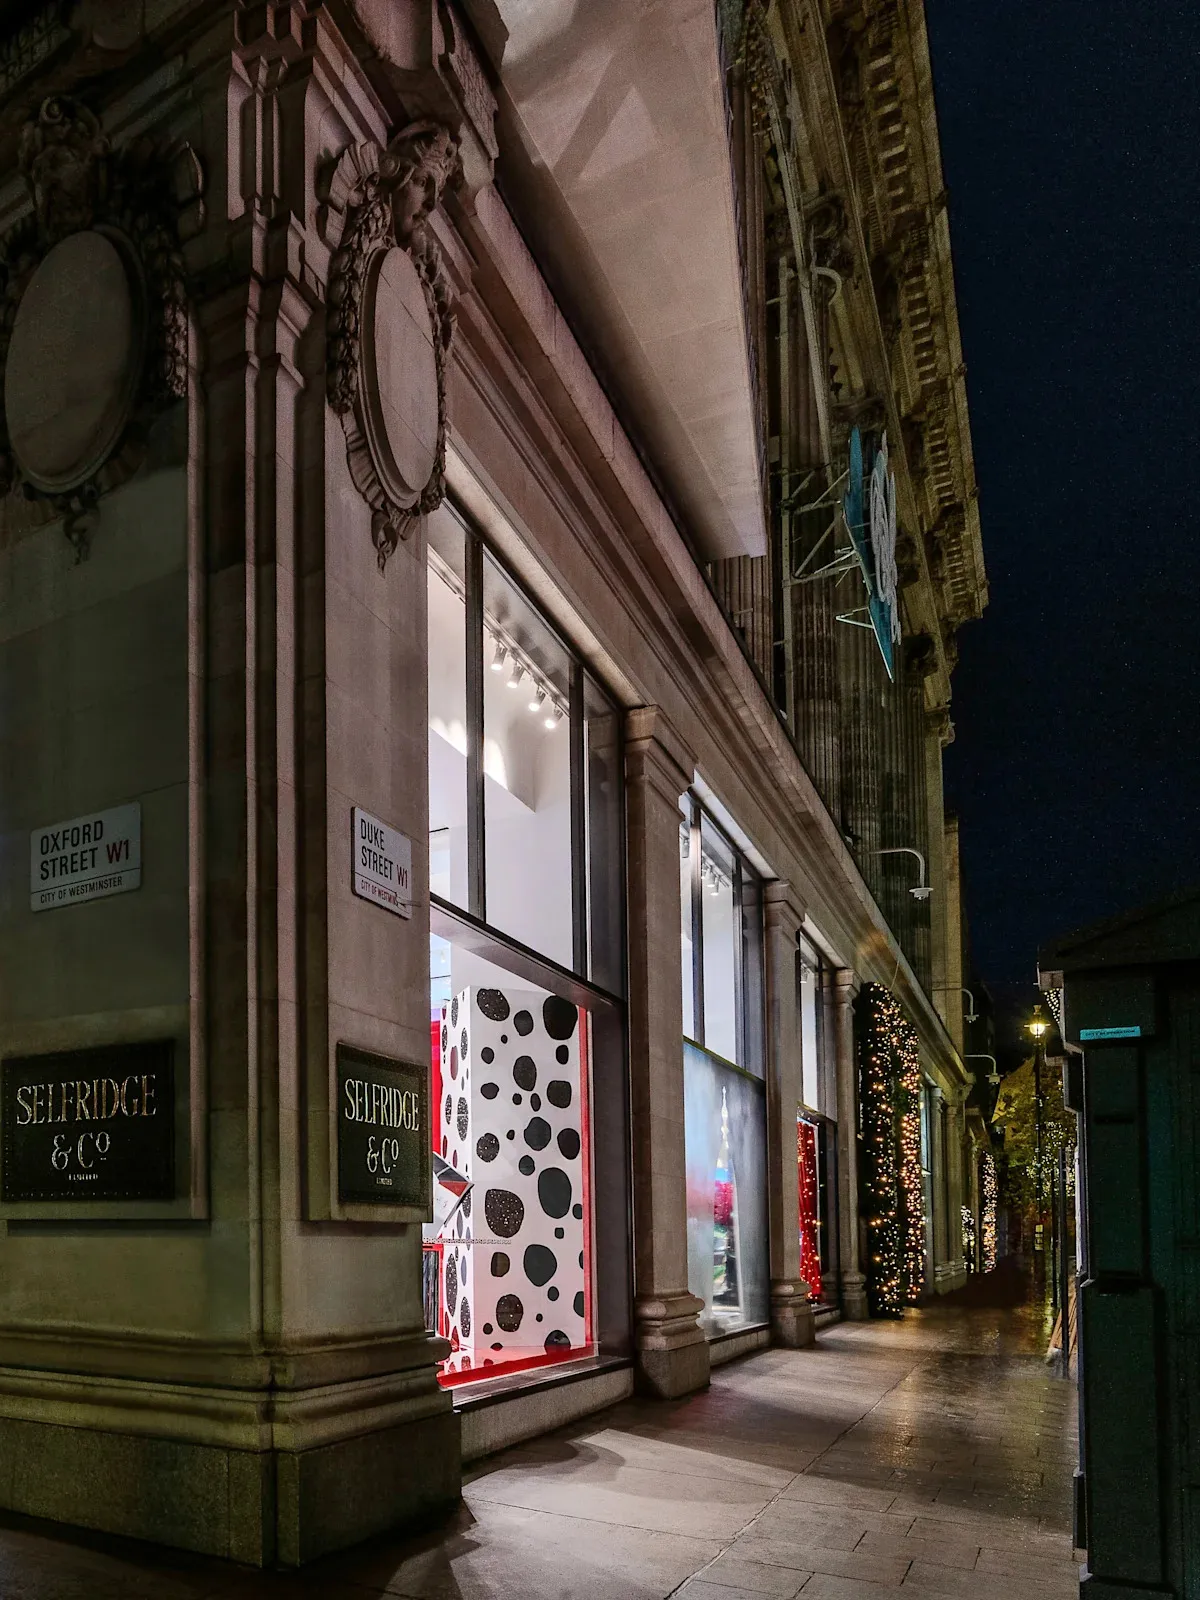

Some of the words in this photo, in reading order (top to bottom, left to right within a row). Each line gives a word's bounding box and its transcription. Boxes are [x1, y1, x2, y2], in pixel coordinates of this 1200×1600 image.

[40, 820, 103, 855] OXFORD
[360, 818, 385, 851] DUKE
[40, 847, 98, 880] STREET
[106, 839, 130, 864] W1
[361, 845, 393, 880] STREET
[396, 864, 408, 889] W1
[40, 890, 56, 904] CITY
[58, 888, 67, 900] OF
[69, 875, 123, 897] WESTMINSTER
[361, 879, 371, 892] CITY
[16, 1074, 157, 1125] SELFRIDGE
[345, 1079, 420, 1131] SELFRIDGE
